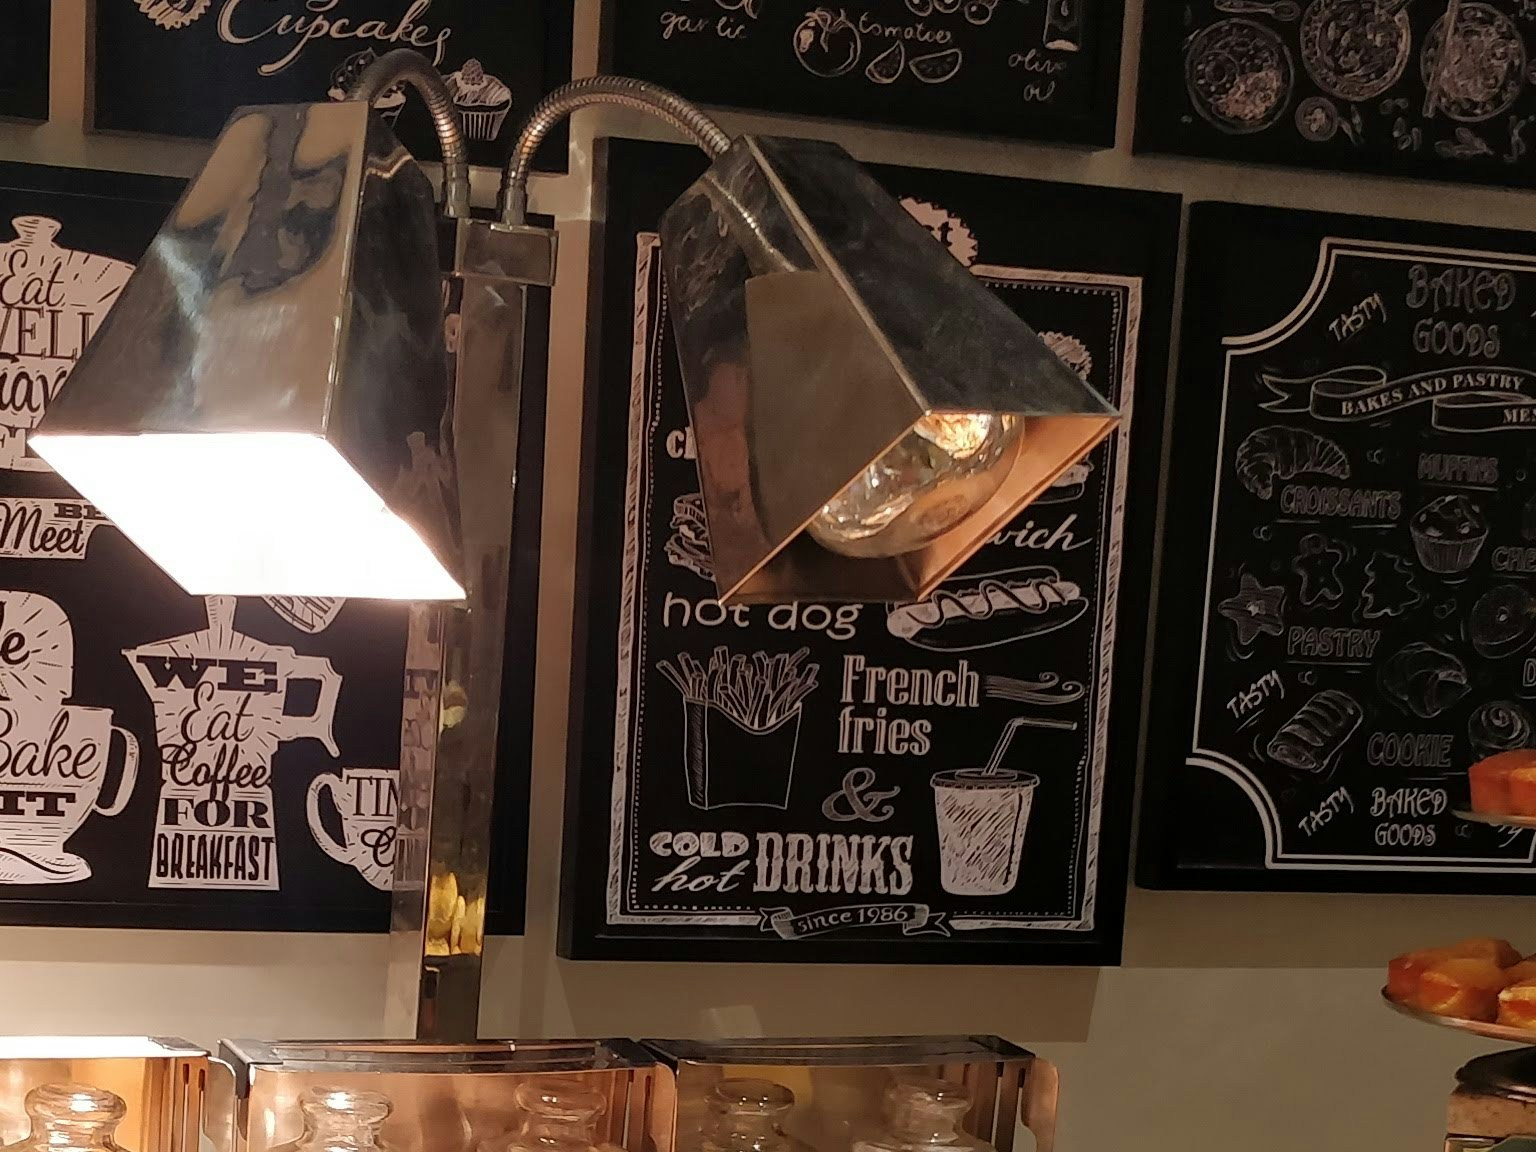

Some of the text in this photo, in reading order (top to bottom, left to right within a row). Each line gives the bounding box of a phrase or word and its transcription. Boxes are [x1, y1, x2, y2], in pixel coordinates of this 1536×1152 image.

[1405, 263, 1517, 312] BAKED
[1328, 292, 1388, 343] TASTY
[1412, 322, 1501, 359] GOODS
[1340, 371, 1526, 416] BAKES AND PASTRY
[1279, 485, 1403, 519] CROISSANTS
[664, 590, 864, 640] hot dog
[1286, 625, 1382, 658] PASTRY
[136, 654, 279, 693] WE
[841, 653, 980, 708] French
[1225, 669, 1286, 721] TASTY
[180, 681, 254, 745] Eat
[838, 707, 932, 755] fries
[159, 741, 271, 802] Coffee
[1366, 731, 1454, 768] COOKIE
[163, 797, 270, 830] FOR
[822, 766, 902, 823] &
[1297, 785, 1354, 839] TASTY
[1369, 787, 1449, 818] BAKED
[156, 833, 276, 883] BREAKFAST
[649, 830, 750, 858] COLD
[1374, 822, 1438, 847] GOODS
[651, 831, 915, 896] hot DRINKS
[796, 905, 910, 933] since 1986
